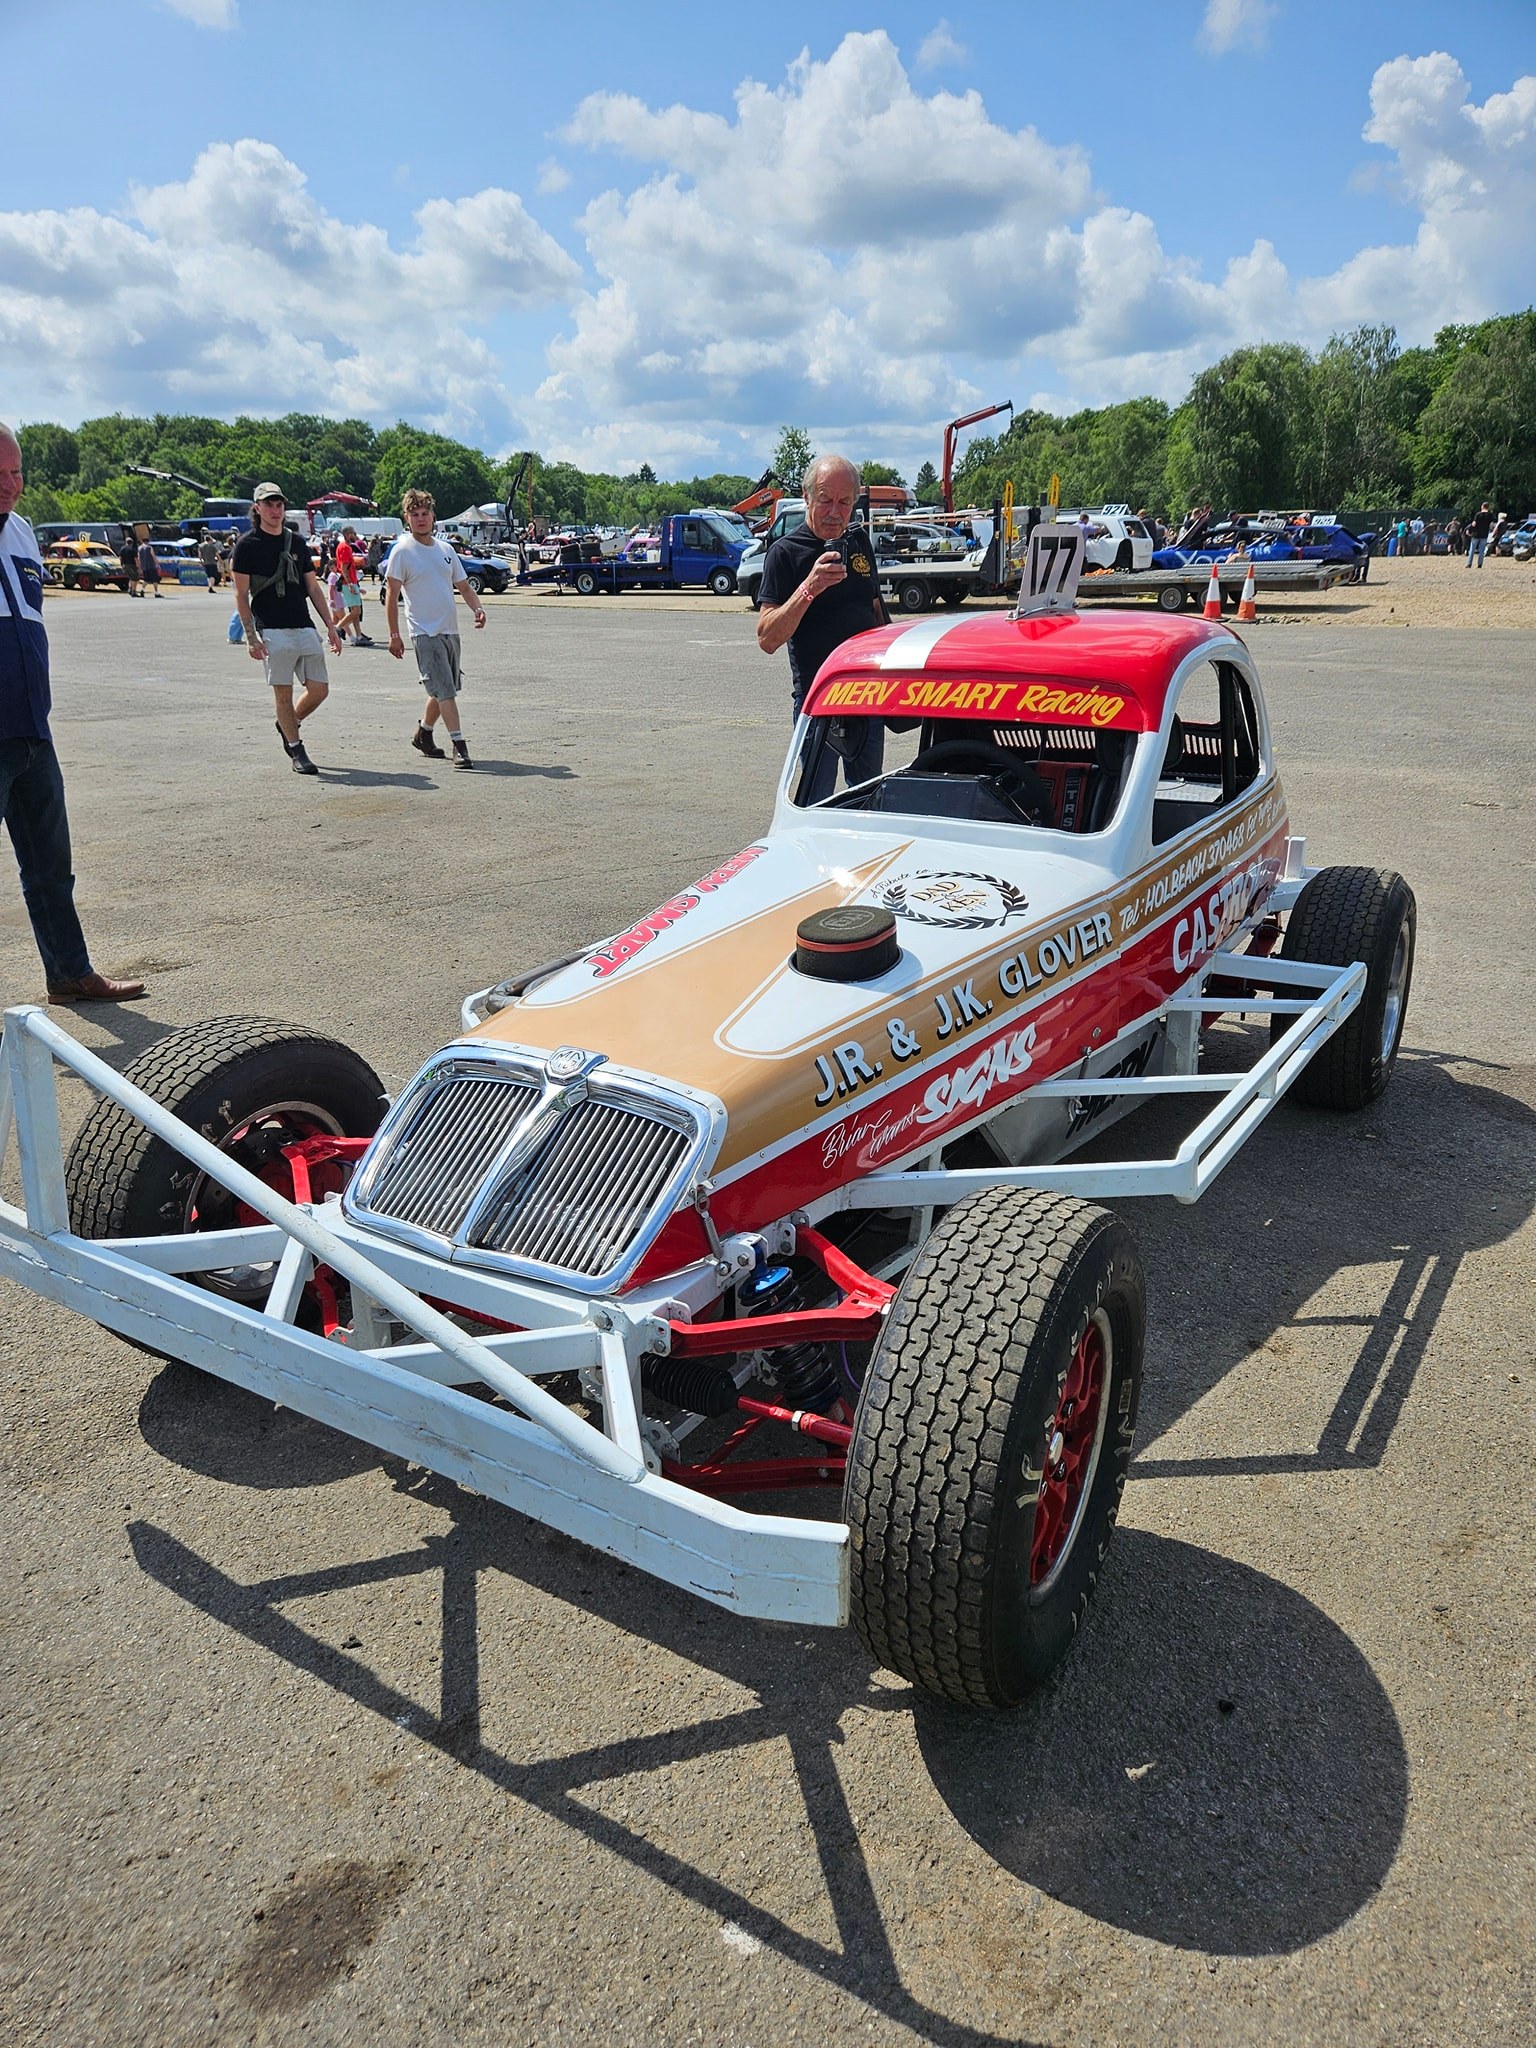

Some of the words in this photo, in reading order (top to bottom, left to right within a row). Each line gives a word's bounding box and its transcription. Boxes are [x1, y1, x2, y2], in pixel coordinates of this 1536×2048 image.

[1103, 505, 1126, 515] 921
[539, 550, 557, 560] 157
[1030, 536, 1078, 597] 177
[822, 681, 899, 706] MERV
[899, 682, 1018, 710] SMART
[1016, 684, 1125, 725] Racing
[910, 881, 960, 901] DAD
[1144, 848, 1209, 916] HOLBEACH
[1207, 822, 1245, 871] 370468
[939, 891, 989, 912] KEN
[583, 893, 701, 978] SMART
[814, 1040, 883, 1107] J.R.
[886, 1017, 921, 1062] &
[935, 977, 994, 1040] J.K.
[997, 911, 1113, 999] GLOVER
[915, 1022, 1037, 1124] SIGNS
